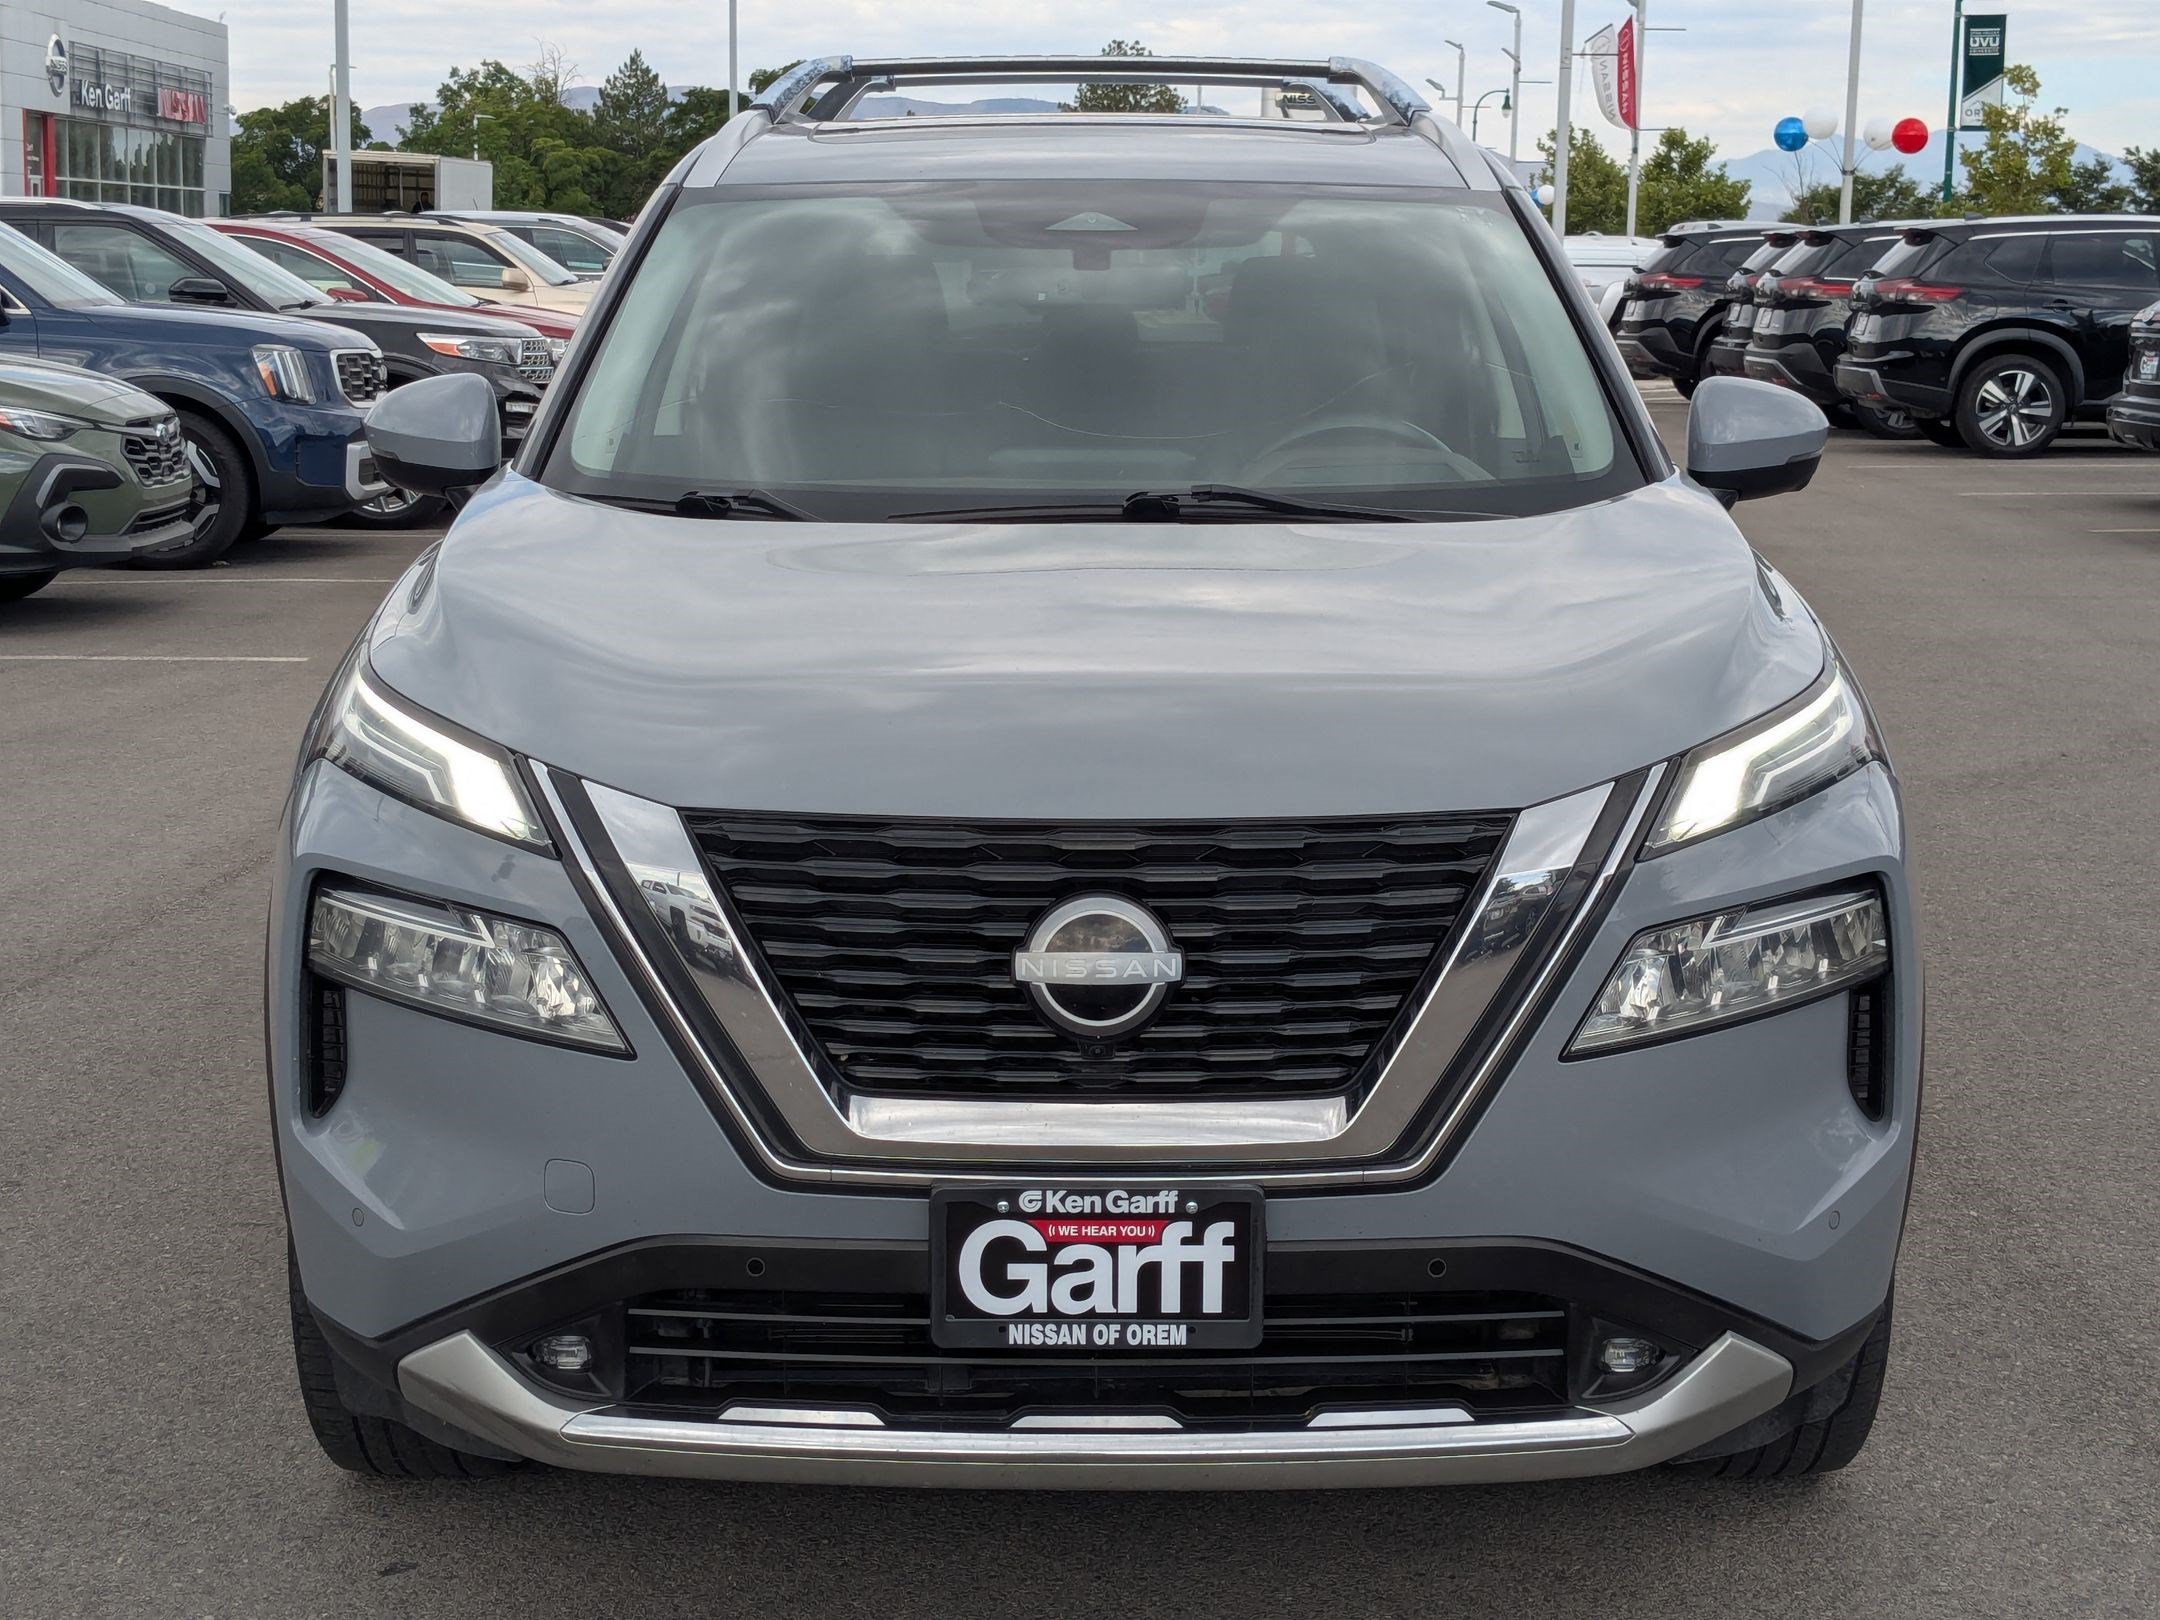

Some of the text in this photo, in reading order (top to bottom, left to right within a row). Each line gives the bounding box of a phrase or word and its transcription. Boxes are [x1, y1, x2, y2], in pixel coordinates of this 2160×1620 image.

[81, 79, 131, 112] Ken Garff
[1283, 94, 1316, 104] NISS
[1021, 958, 1176, 978] NISSAN
[1046, 1190, 1178, 1214] Ken Garff
[1058, 1225, 1146, 1236] WE HEAR YOU
[958, 1219, 1235, 1316] Garff
[1008, 1323, 1187, 1346] NISSAN OF OREM
